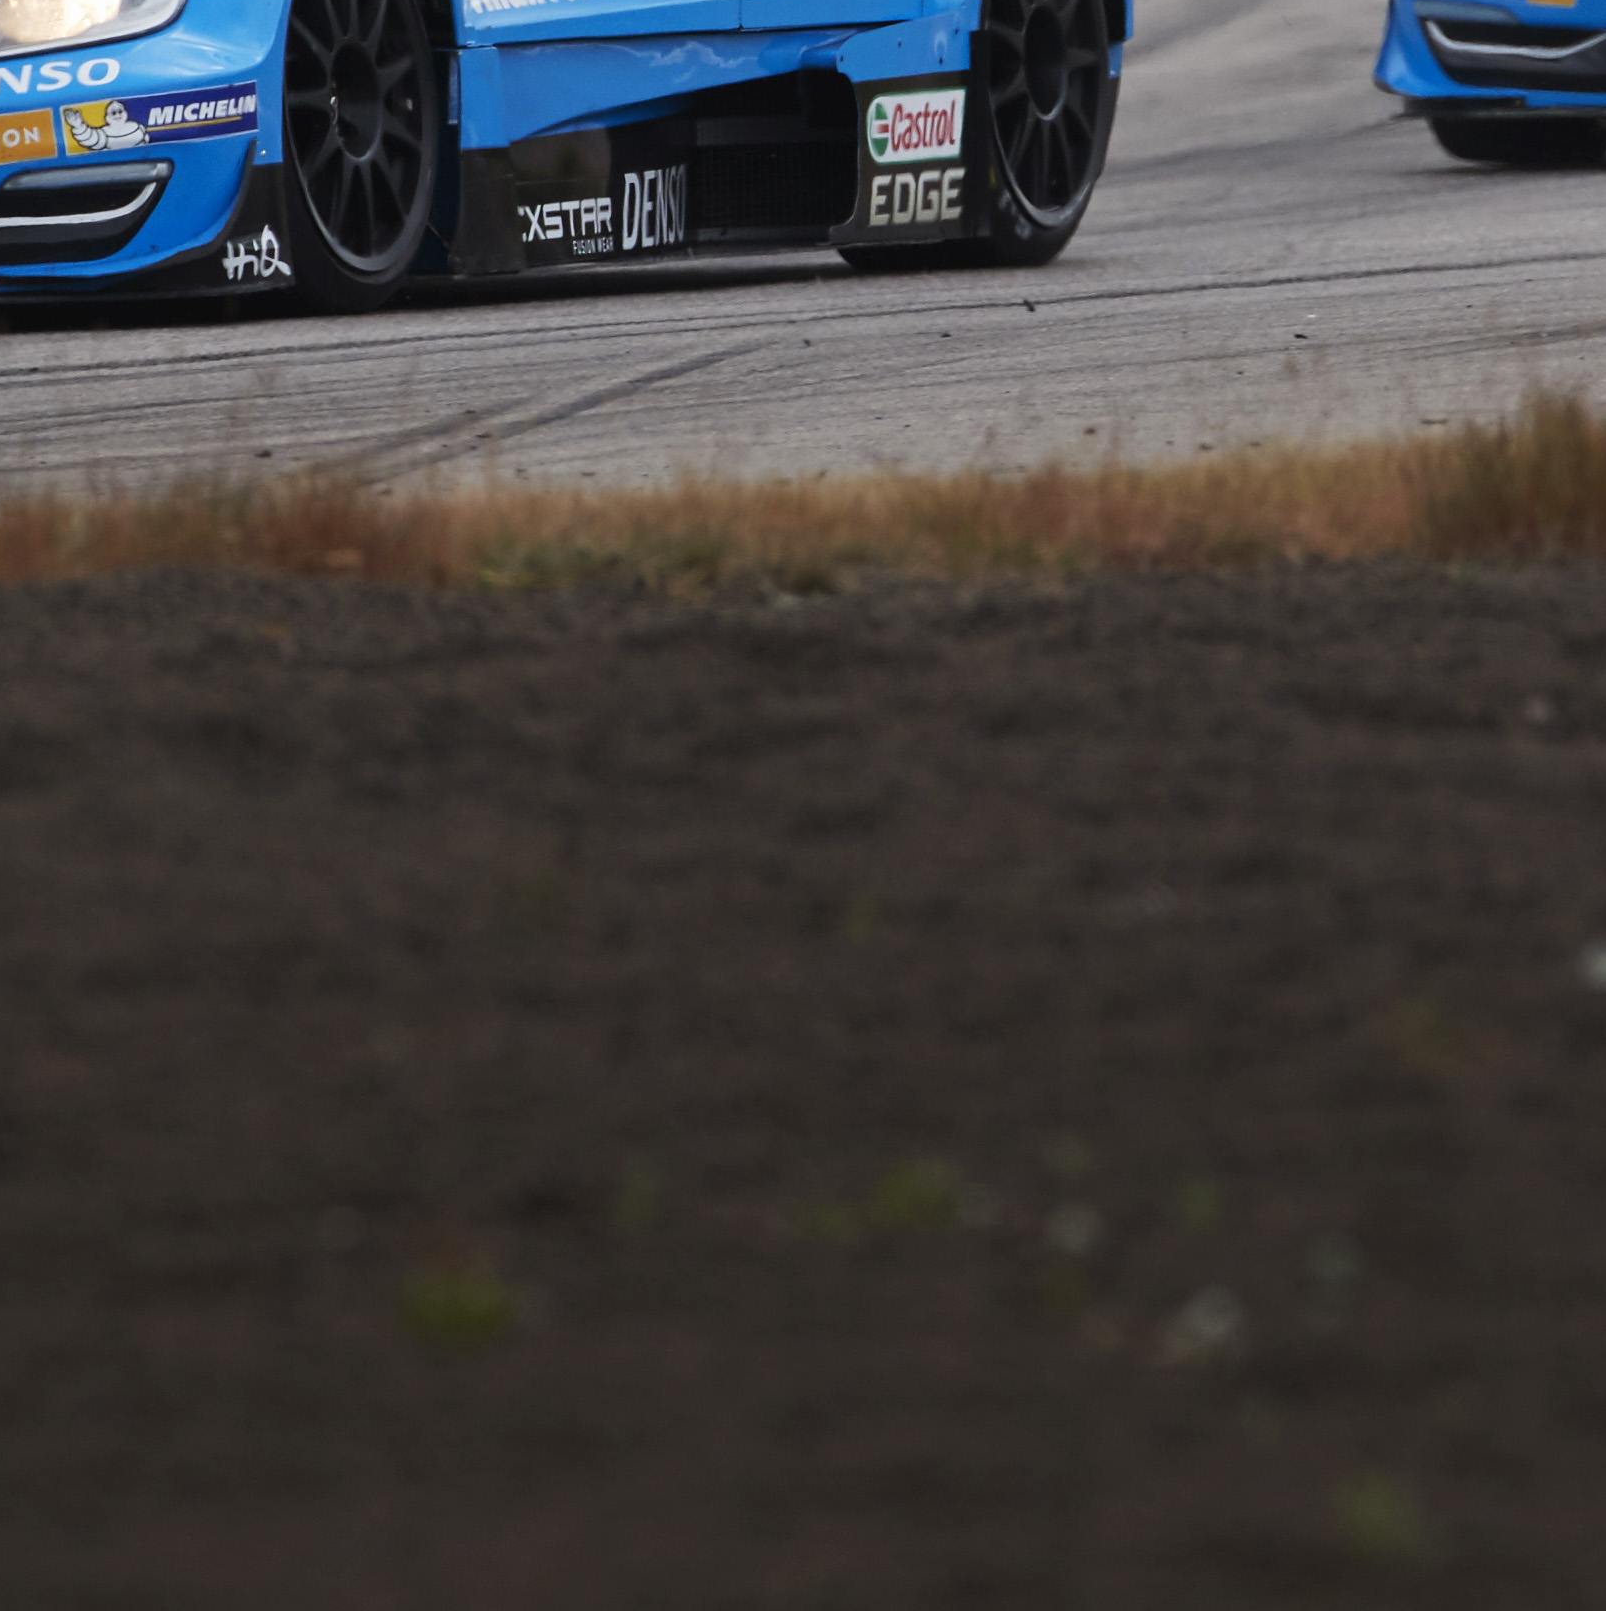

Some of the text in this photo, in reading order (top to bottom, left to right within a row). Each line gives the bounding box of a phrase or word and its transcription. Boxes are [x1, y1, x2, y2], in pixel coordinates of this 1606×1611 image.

[148, 94, 257, 125] MICHELIN
[891, 99, 956, 153] Castrol
[622, 164, 688, 250] DENSO
[869, 167, 966, 227] EDGE
[221, 224, 291, 281] HiQ
